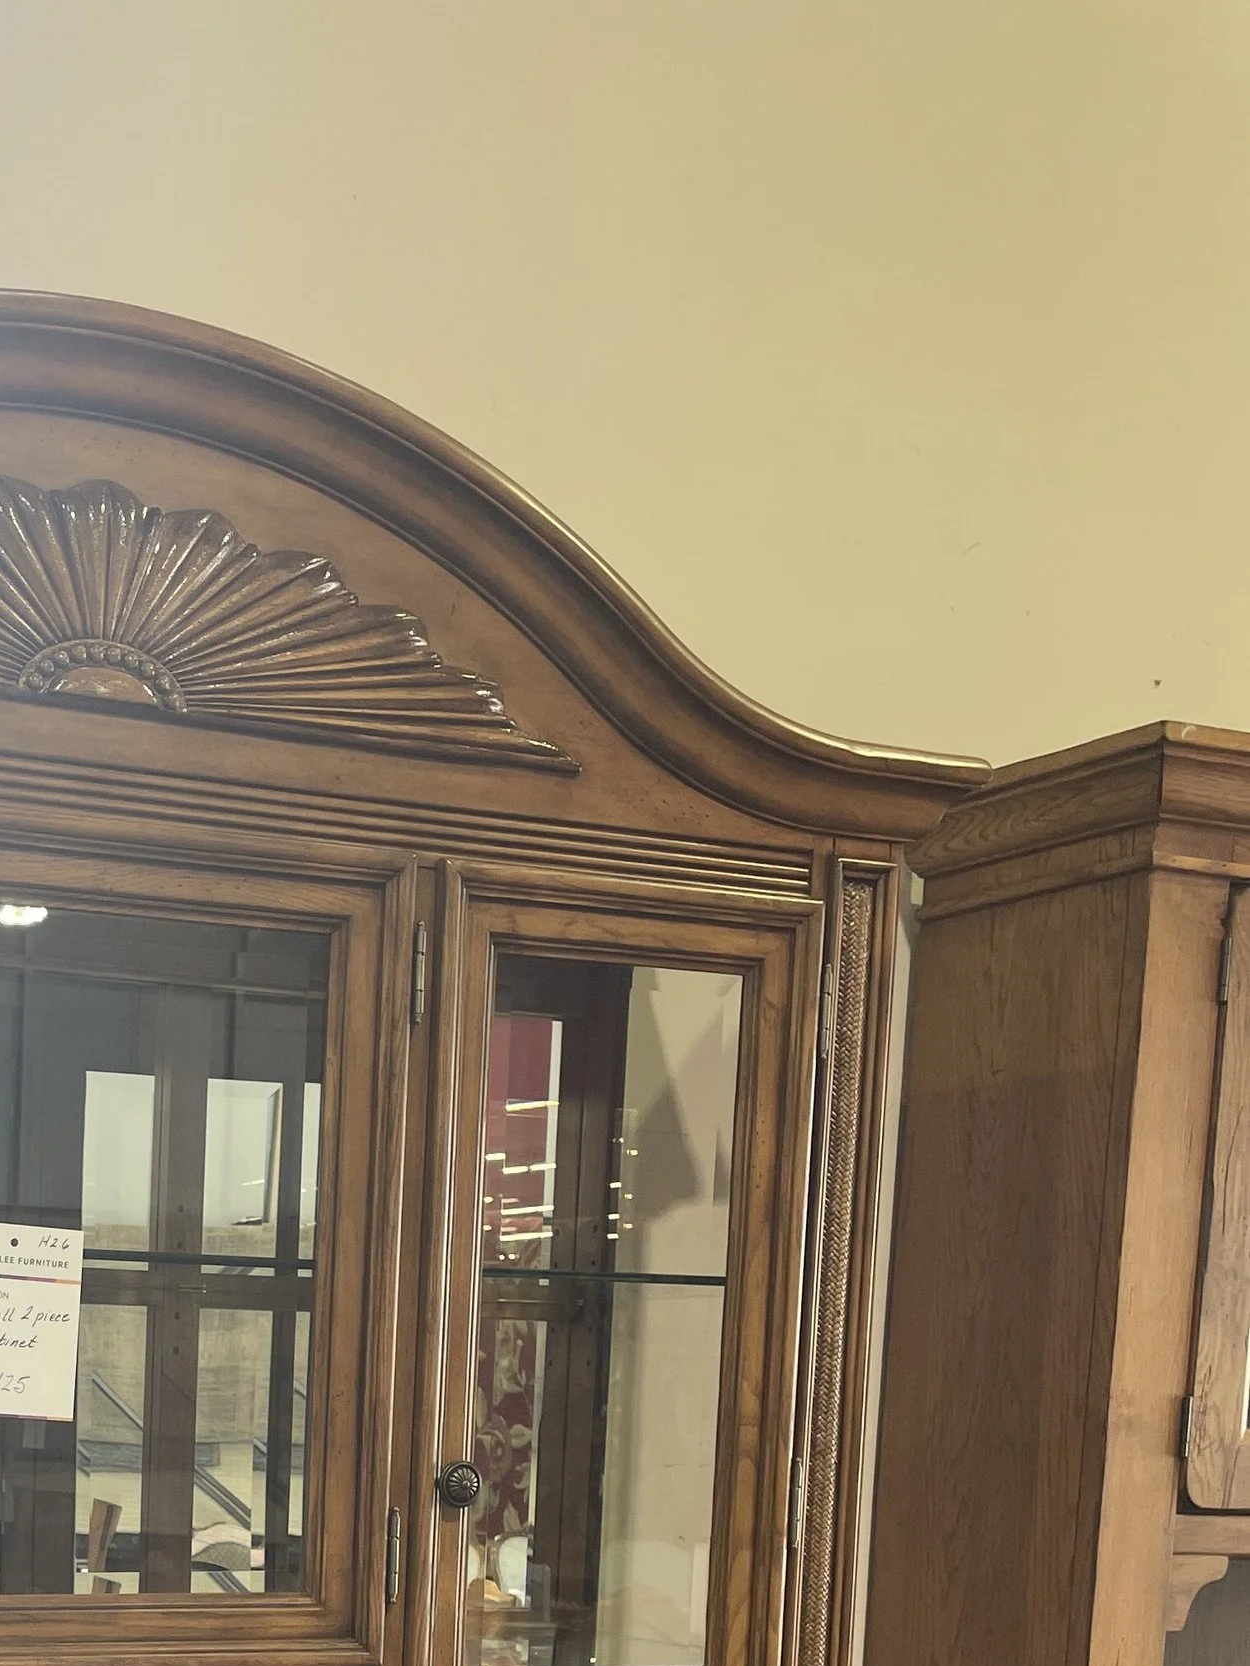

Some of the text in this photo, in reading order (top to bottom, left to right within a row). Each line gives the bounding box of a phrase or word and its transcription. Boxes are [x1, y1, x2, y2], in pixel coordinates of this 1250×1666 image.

[17, 1256, 70, 1269] FURNITURE
[20, 1305, 34, 1321] 2
[33, 1311, 71, 1328] piece
